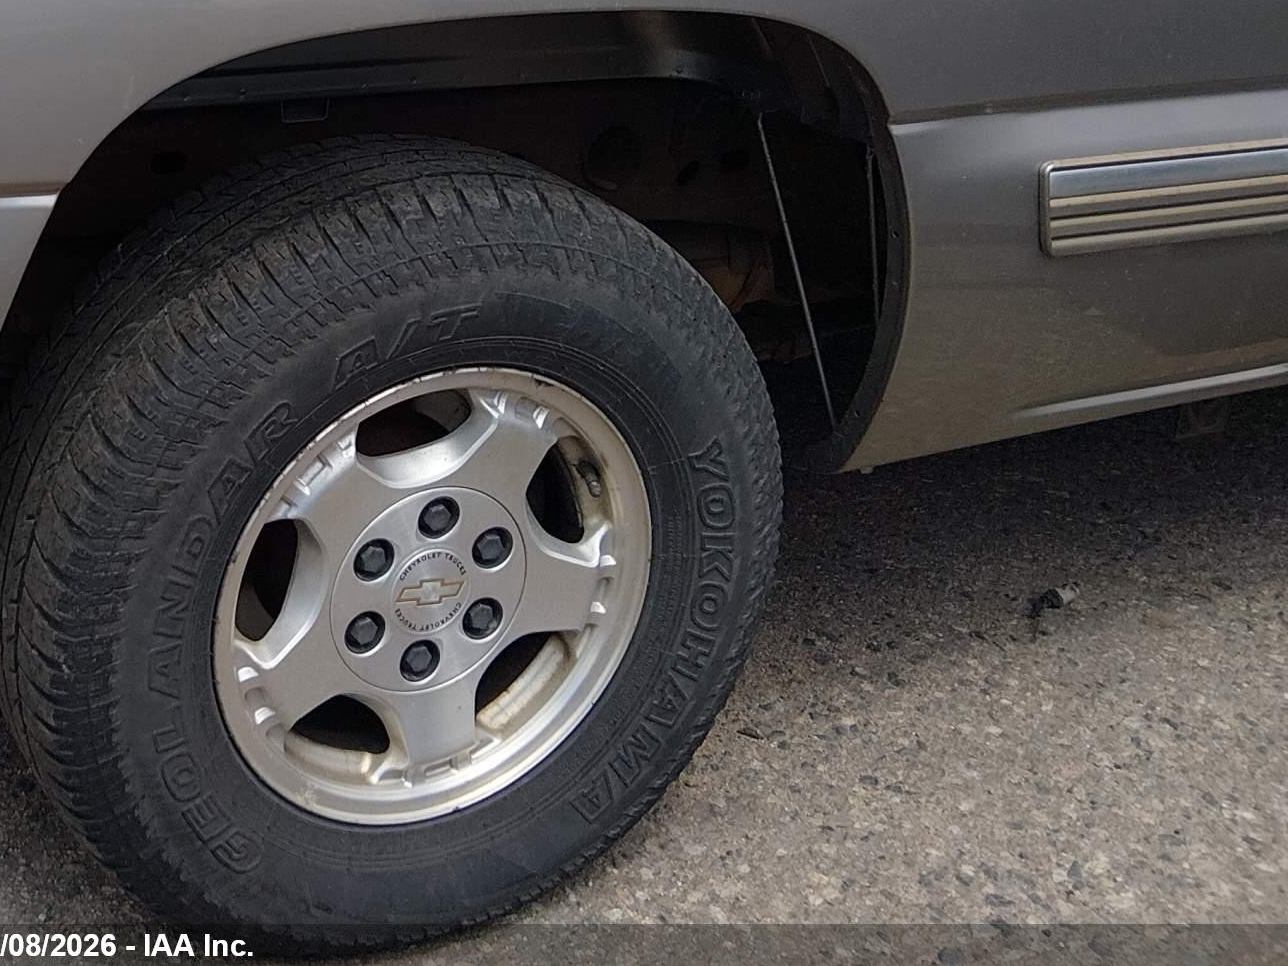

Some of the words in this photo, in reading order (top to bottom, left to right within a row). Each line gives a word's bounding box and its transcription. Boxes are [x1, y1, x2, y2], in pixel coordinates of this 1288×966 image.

[147, 400, 300, 875] GEOLANDAR
[330, 301, 482, 392] A/T
[399, 552, 443, 581] CHEVROLET
[444, 552, 467, 576] TRUCKS
[568, 437, 737, 826] YOKOHAMA
